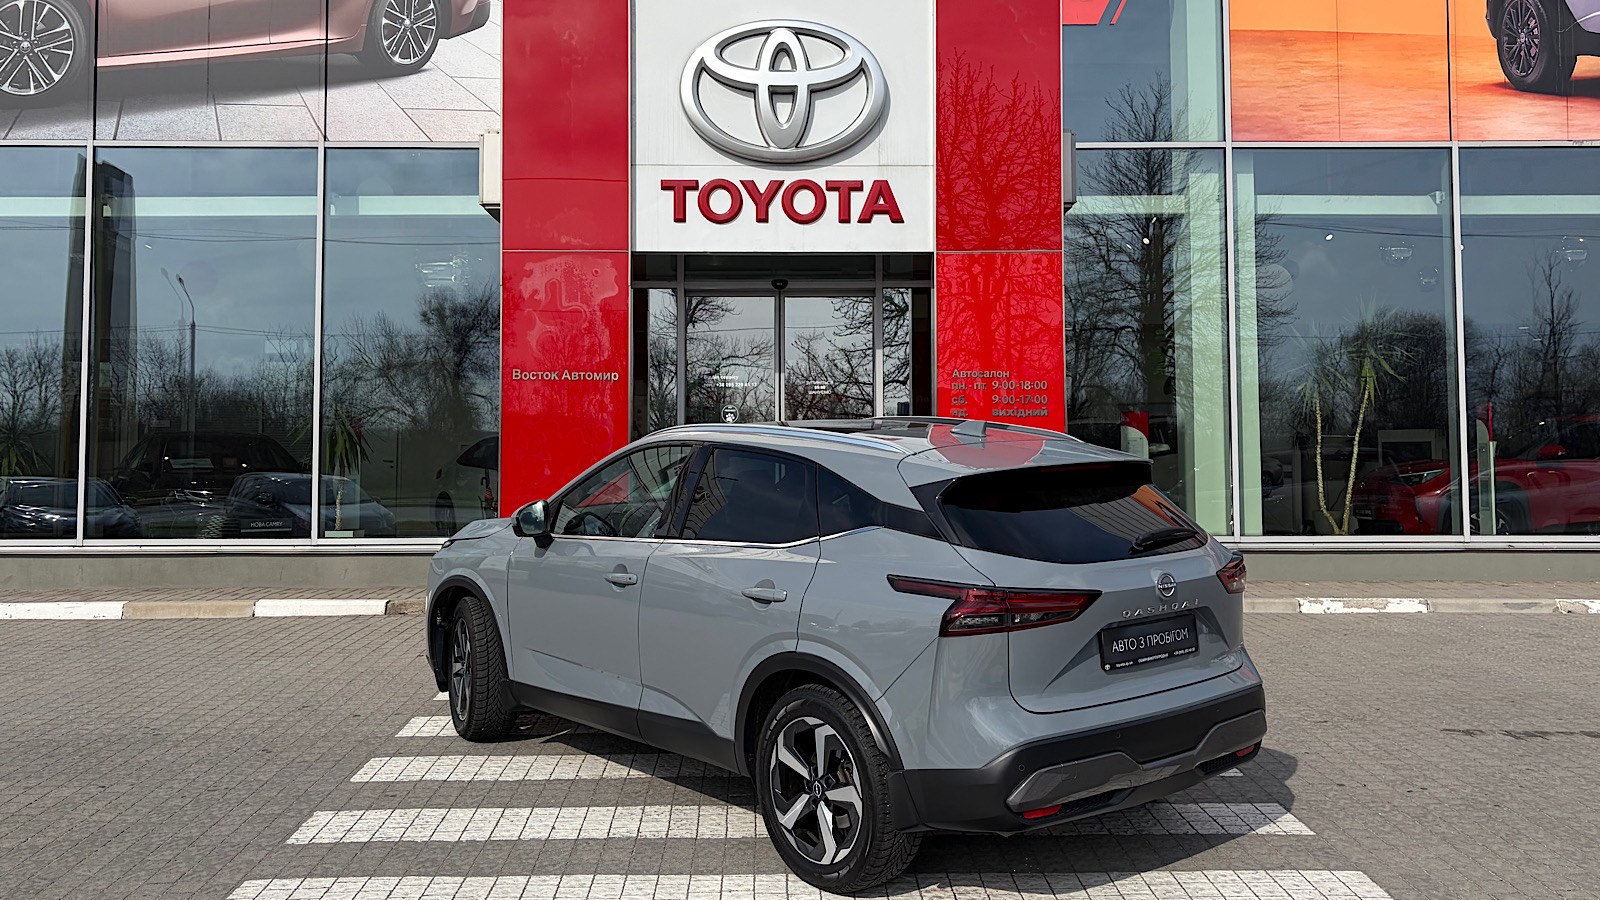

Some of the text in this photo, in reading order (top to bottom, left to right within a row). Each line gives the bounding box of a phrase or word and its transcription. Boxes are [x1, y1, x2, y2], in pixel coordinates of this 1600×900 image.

[661, 178, 904, 224] TOYOTA
[512, 369, 619, 384] Восток Автомир
[952, 368, 1010, 379] Автосалон
[952, 394, 1048, 405] сб. 9:00-17:00
[992, 407, 1048, 418] вихідний
[1122, 598, 1199, 618] QASHQAI
[1112, 638, 1137, 653] АВТО
[1146, 627, 1189, 647] ПРОБІГОМ
